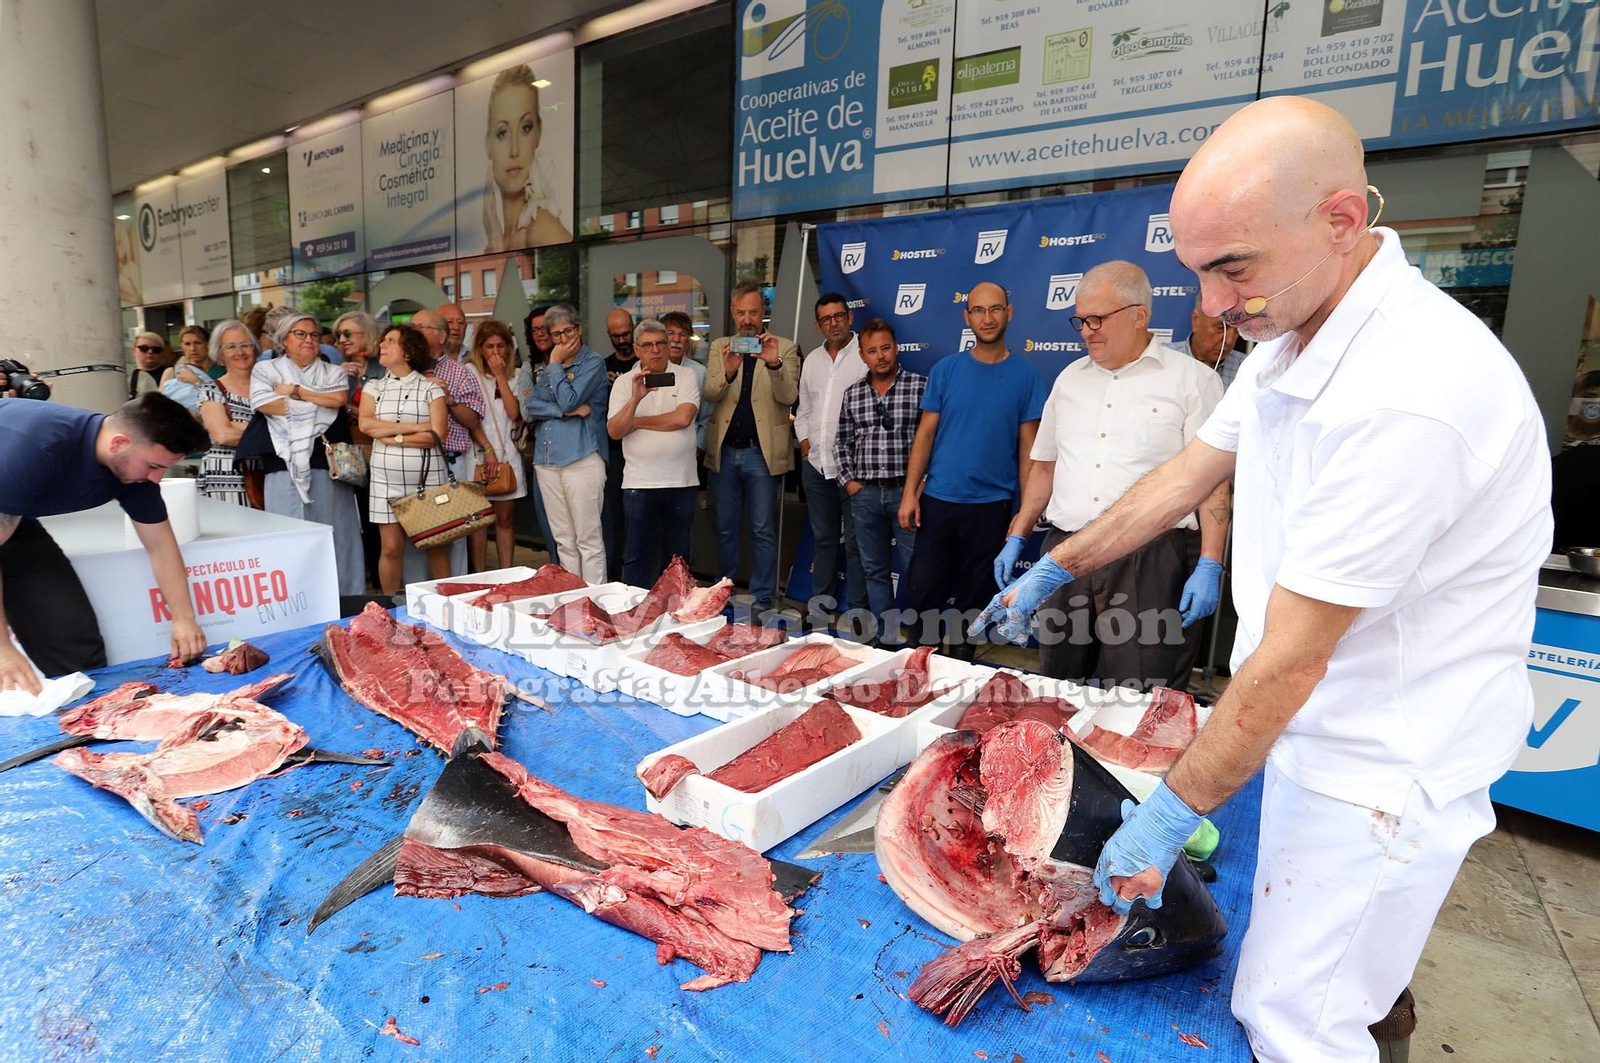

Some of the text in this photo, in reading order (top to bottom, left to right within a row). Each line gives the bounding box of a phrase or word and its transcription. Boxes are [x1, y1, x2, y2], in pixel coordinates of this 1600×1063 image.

[981, 18, 993, 26] Tel.
[995, 13, 1009, 22] 959
[1027, 7, 1041, 16] 061
[1000, 21, 1019, 31] BEAS
[907, 38, 941, 50] ALMONTE
[1111, 32, 1193, 59] OleoCampiña
[1306, 34, 1394, 56] Tel. 959 410 702
[1206, 63, 1221, 72] Tel.
[1224, 59, 1242, 69] 959
[1266, 52, 1285, 63] 284
[1303, 45, 1394, 68] BOLLULLOS PAR
[956, 59, 1016, 81] olipaterna
[1112, 69, 1183, 87] Tel. 959 307 014
[1213, 65, 1274, 81] VILLARRASA
[1303, 58, 1390, 80] DEL CONDADO
[740, 70, 866, 111] Cooperativas de
[891, 83, 923, 96] Ostur
[1050, 88, 1063, 96] 959
[1121, 81, 1173, 96] TRIGUEROS
[956, 96, 1014, 111] Tel. 959 428 229
[1033, 91, 1097, 108] SAN BARTOLOMÉ
[1040, 103, 1088, 116] DE LA TORRE
[739, 94, 864, 147] Aceite de
[926, 109, 938, 117] 204
[945, 105, 1024, 123] PATERNA DEL CAMPO
[1402, 114, 1429, 132] LA
[1442, 101, 1531, 128] MEJOR
[888, 119, 934, 131] MANZANILLA
[380, 128, 439, 157] Medicina y
[399, 143, 440, 168] Cirugía
[738, 136, 864, 187] Huelva
[380, 165, 435, 191] Cosmética
[386, 183, 429, 208] Integral
[157, 196, 220, 227] Embryocenter
[334, 203, 354, 215] CARMEN
[186, 557, 261, 578] PECTÁCULO DE
[149, 569, 289, 623] RNQUEO
[256, 591, 308, 625] EN VIVO
